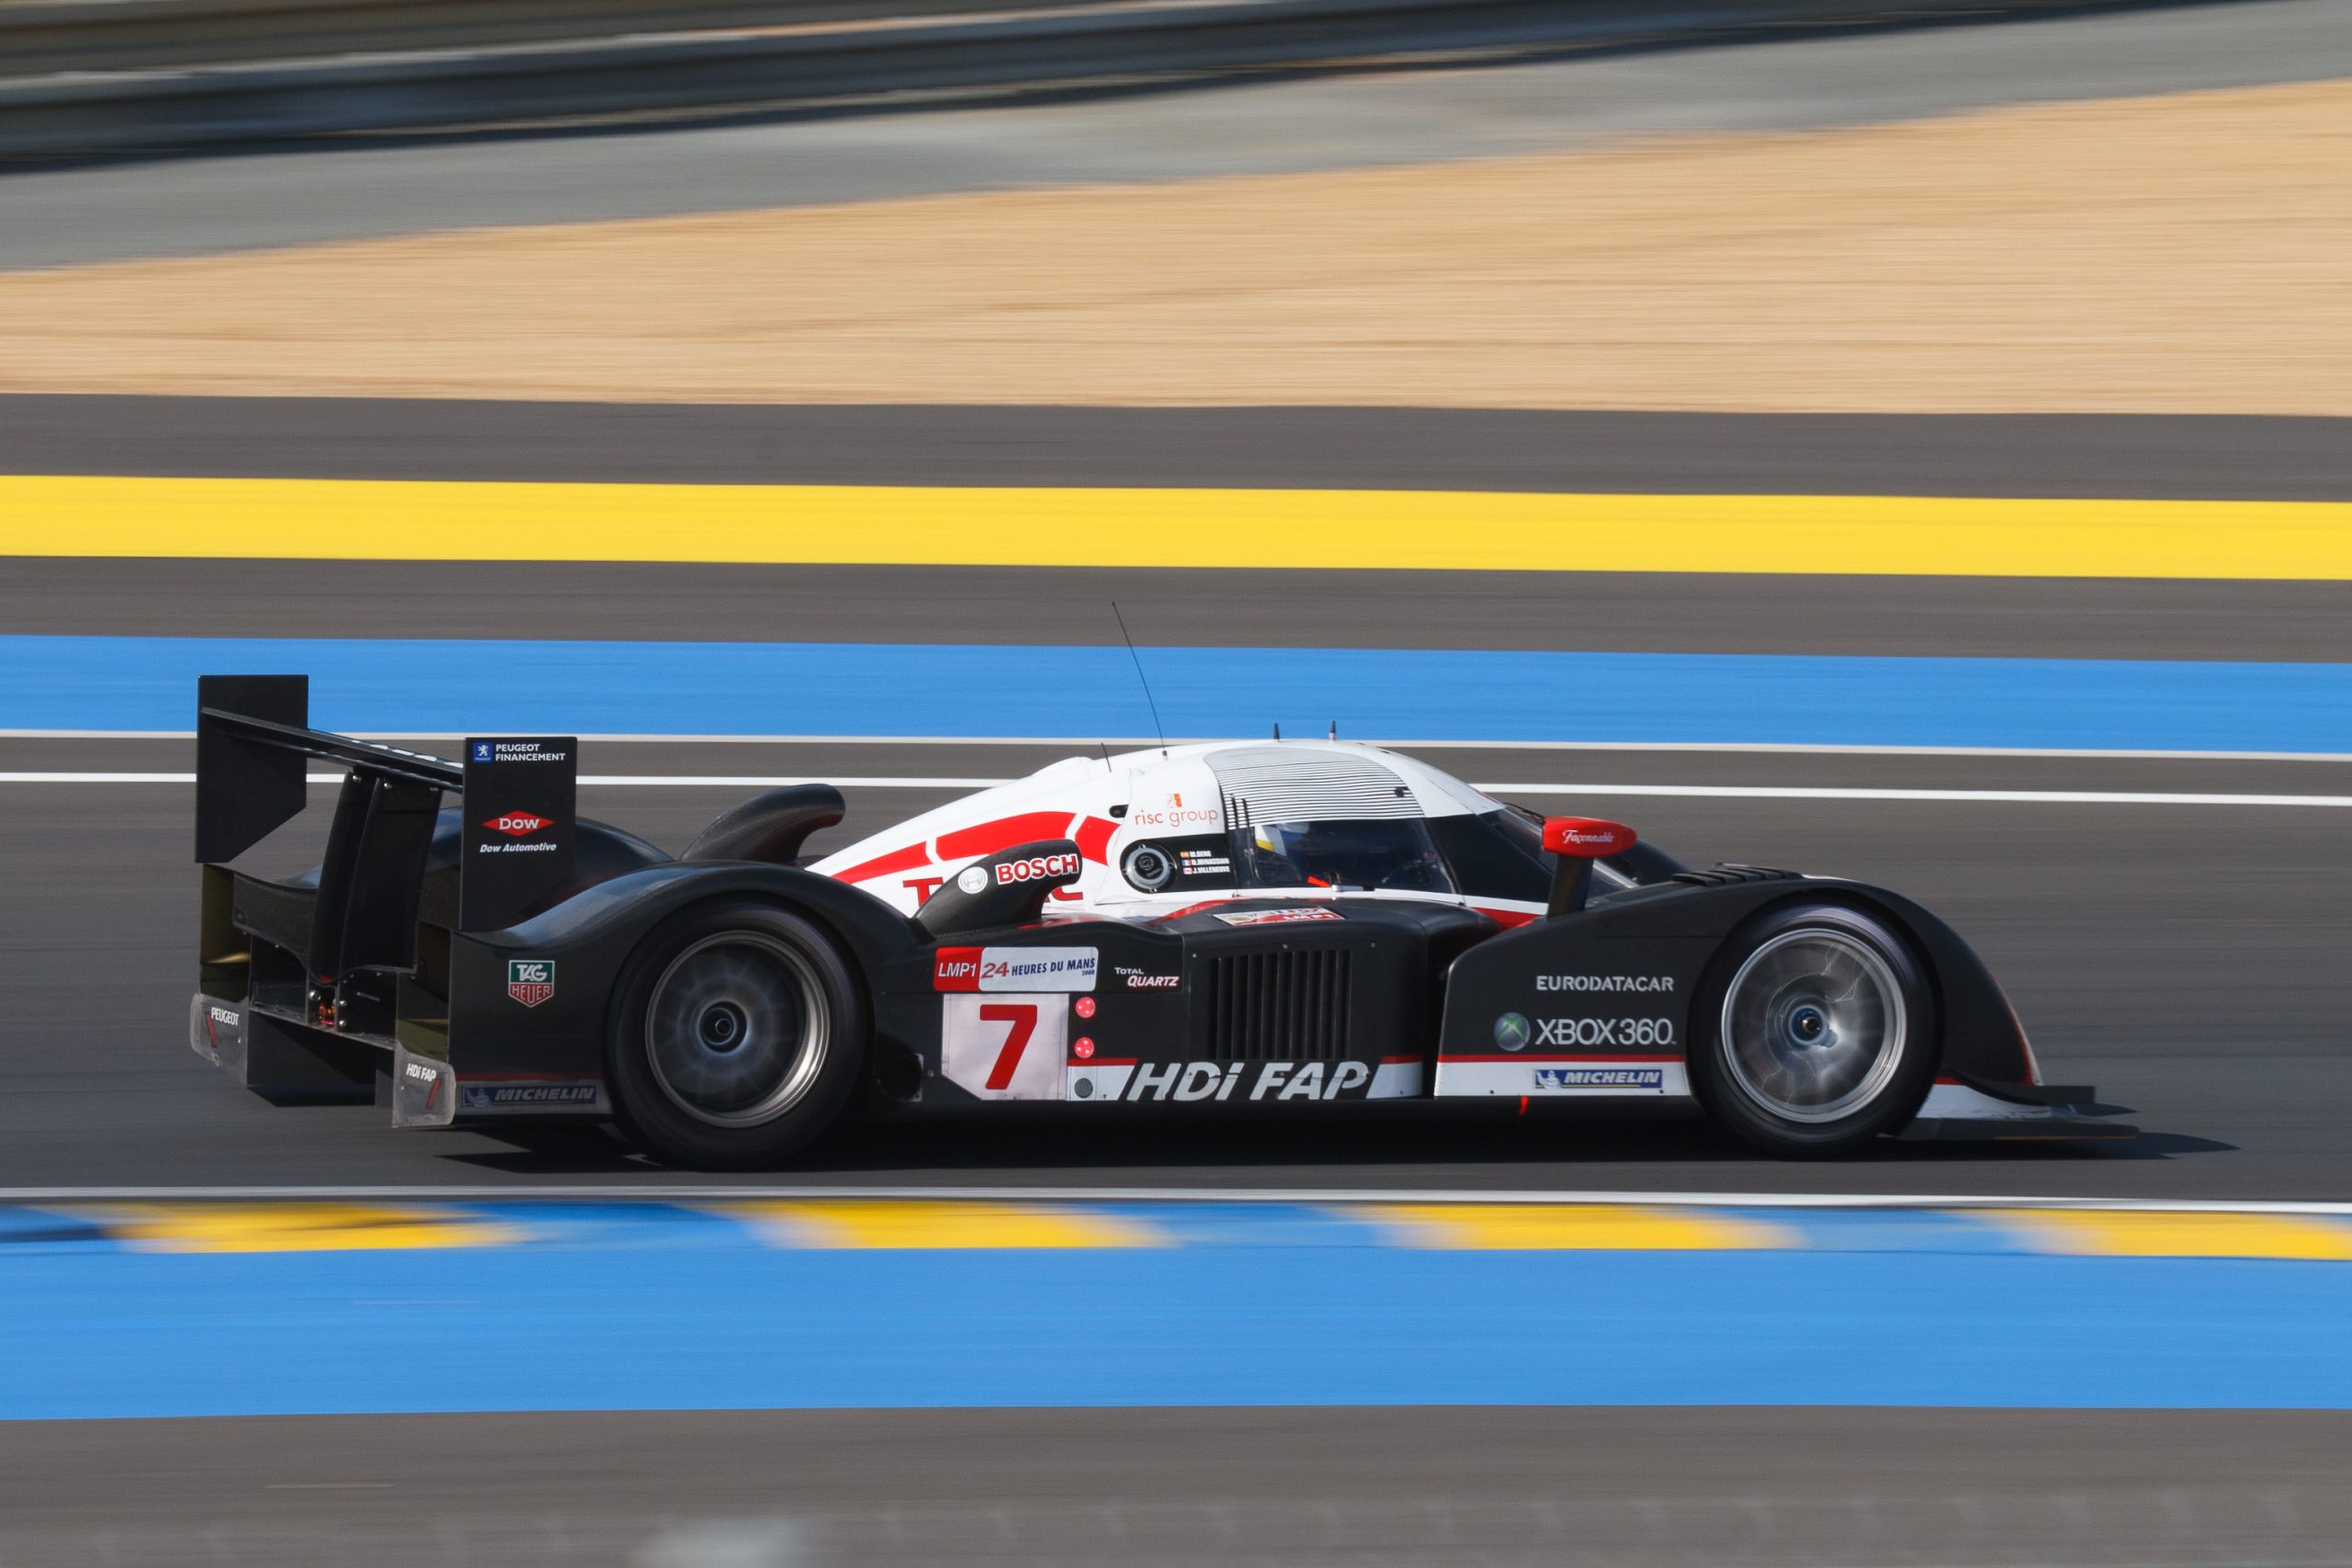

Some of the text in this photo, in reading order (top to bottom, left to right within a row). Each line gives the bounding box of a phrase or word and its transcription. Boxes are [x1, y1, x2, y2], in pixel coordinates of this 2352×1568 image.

[495, 743, 540, 752] PEUGEOT
[495, 752, 566, 761] FINANCEMENT
[1134, 809, 1218, 828] risc group
[480, 842, 557, 852] Dow Automotive
[997, 855, 1080, 884] BOSCH
[516, 964, 548, 982] TAG
[938, 957, 1096, 979] LMP1 24 HEURES DU MANS
[1114, 966, 1145, 976] TOTAL
[1127, 976, 1180, 987] QUARTZ
[1536, 975, 1674, 992] EURODATACAR
[512, 985, 551, 1004] HEUER
[211, 1006, 240, 1026] PEUGEOT
[1535, 1018, 1674, 1045] XBOX 360
[979, 1004, 1038, 1090] 7
[420, 1066, 437, 1082] FAP
[1126, 1061, 1371, 1101] HDi FAP
[1564, 1071, 1661, 1084] MICHELIN
[494, 1087, 595, 1101] MICHELIN
